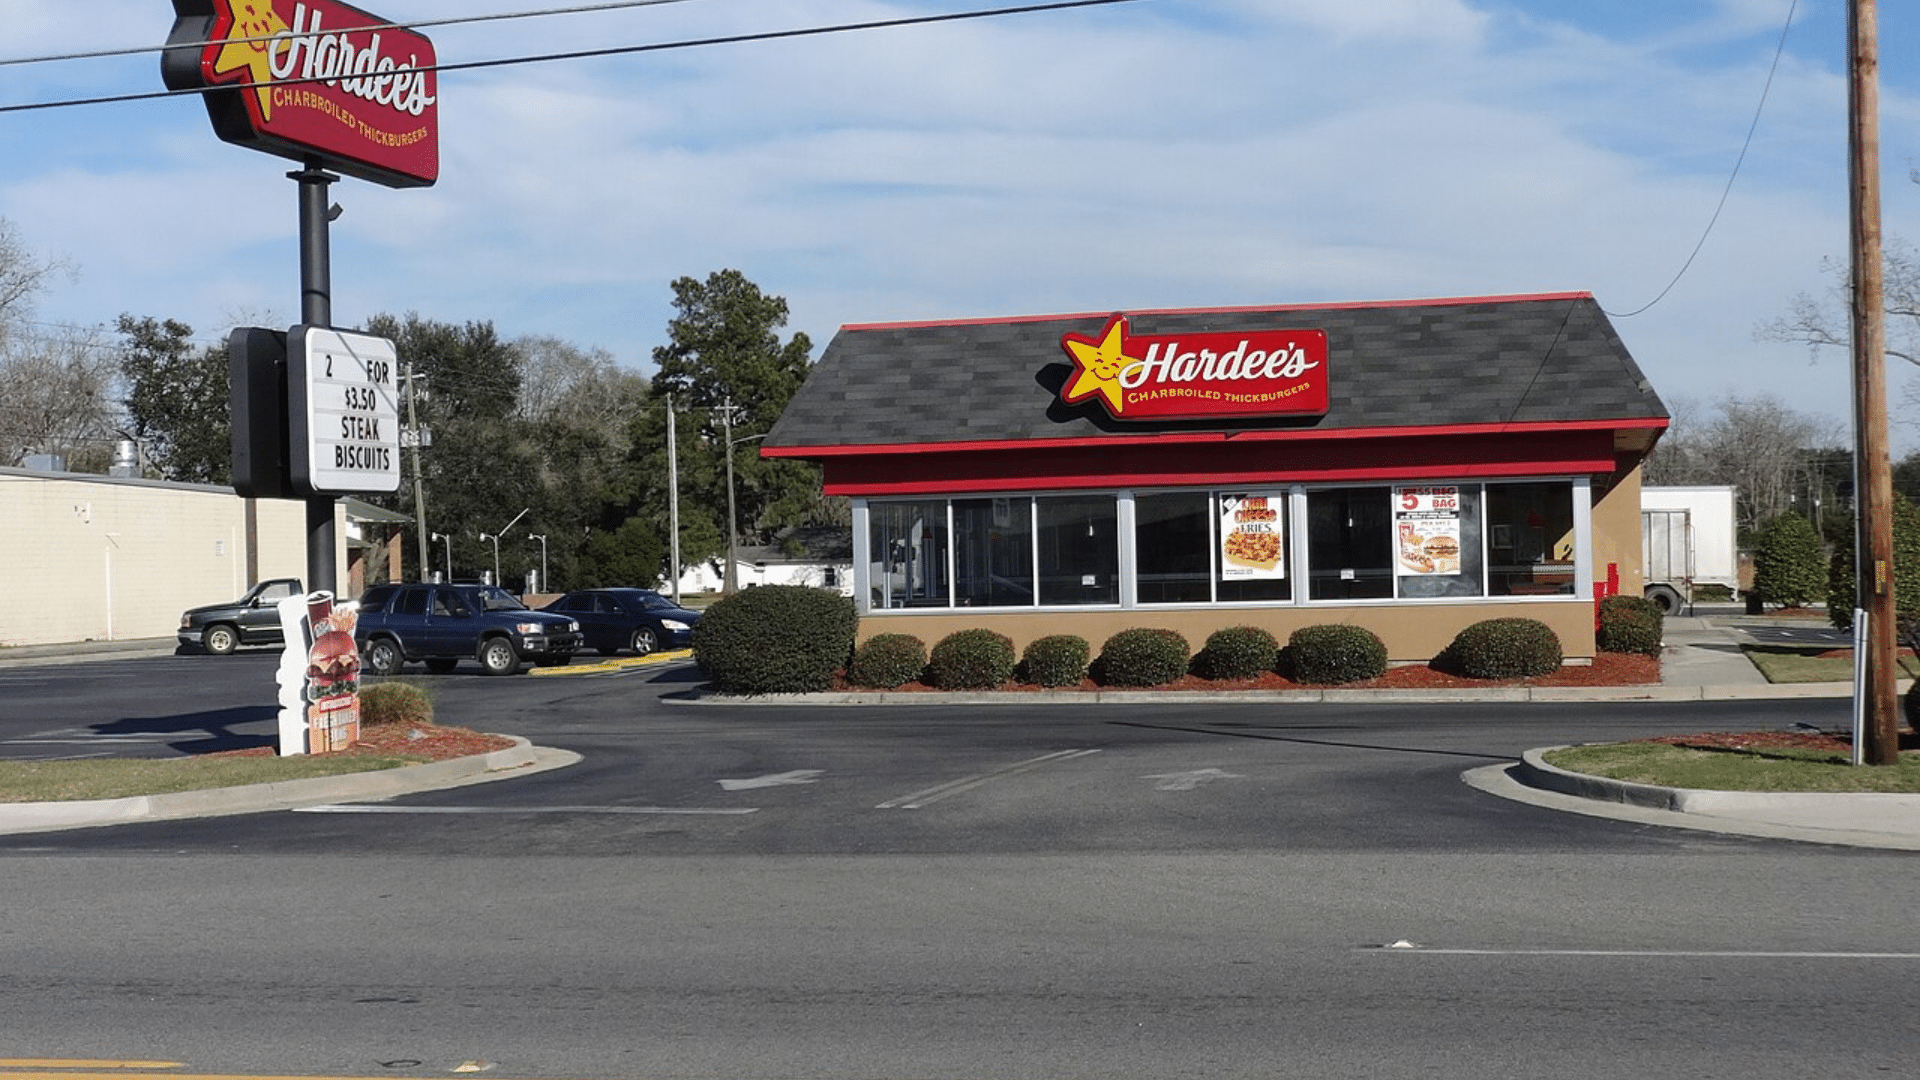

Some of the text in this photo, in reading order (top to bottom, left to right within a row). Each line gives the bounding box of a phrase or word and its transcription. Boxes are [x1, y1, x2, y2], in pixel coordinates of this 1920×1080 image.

[268, 2, 435, 116] Hardee's
[273, 87, 428, 147] CHARBROILED THICKBURGERS
[325, 354, 389, 384] 2 FOR
[1118, 340, 1319, 388] Hardee's
[345, 387, 376, 411] $3.50
[1127, 381, 1311, 404] CHARBROILED THICKBURGERS
[341, 416, 379, 440] STEAK
[335, 445, 390, 470] BISCUITS
[1432, 499, 1456, 507] BAG
[1240, 523, 1271, 533] FRIES
